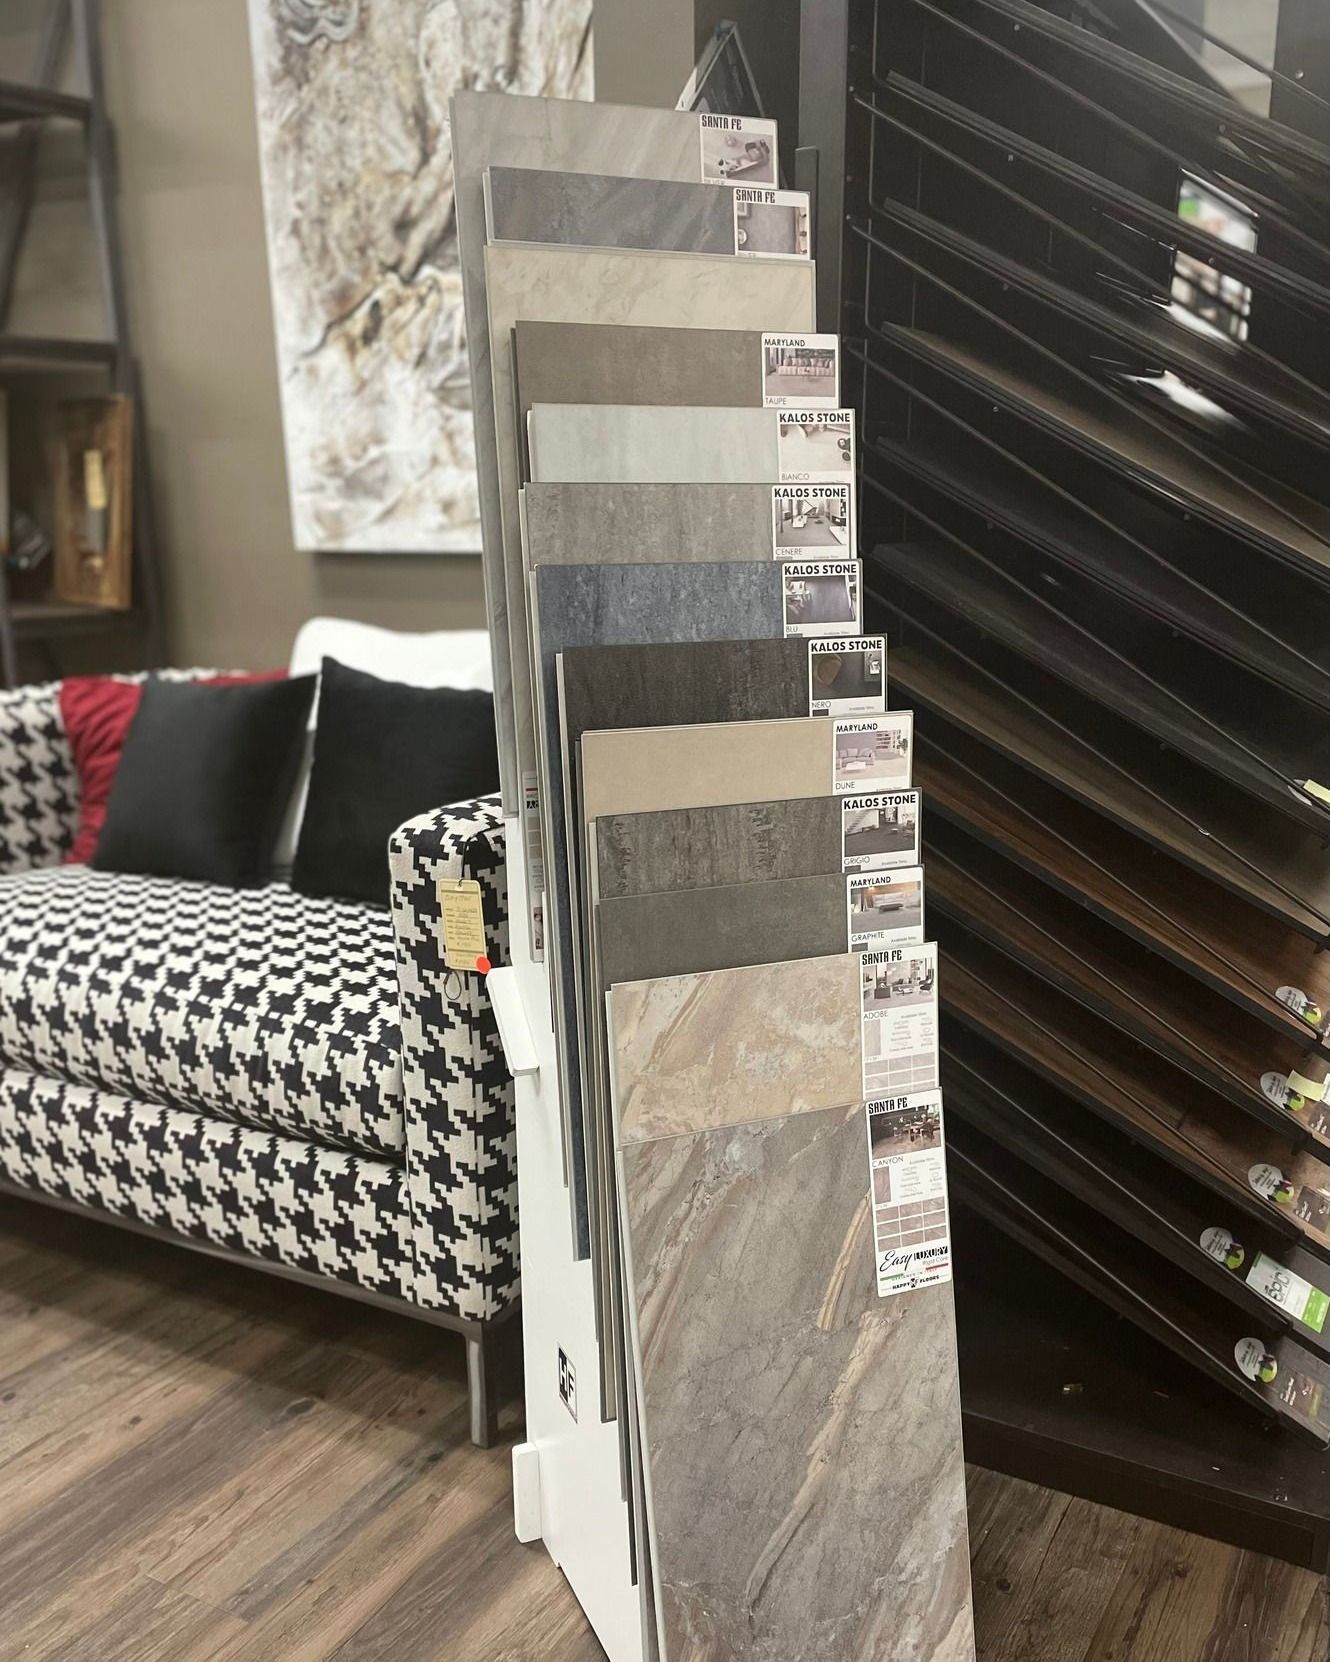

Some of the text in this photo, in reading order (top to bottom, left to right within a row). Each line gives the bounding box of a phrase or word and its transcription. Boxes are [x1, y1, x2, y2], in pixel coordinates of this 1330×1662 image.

[702, 114, 742, 131] SANTA FE
[736, 189, 776, 204] SANTA FE
[764, 338, 806, 347] MARYLAND
[765, 397, 787, 405] TAUPE
[779, 412, 850, 423] KALOS STONE
[781, 473, 810, 481] BIANCO
[774, 488, 846, 498] KALOS STONE
[775, 548, 803, 556] CENERE
[784, 564, 857, 575] KALOS STONE
[786, 625, 798, 633] BLU
[811, 640, 882, 652] KALOS STONE
[811, 701, 832, 709] NERO
[836, 722, 878, 733] MARYLAND
[835, 781, 855, 790] DUNE
[844, 794, 916, 810] KALOS STONE
[843, 855, 871, 865] GRIGIO
[850, 876, 892, 887] MARYLAND
[851, 932, 885, 942] GRAPHITE
[862, 949, 902, 965] SANTA FE
[863, 1010, 888, 1020] ADOBE
[868, 1097, 908, 1114] SANTA FE
[872, 1156, 904, 1168] CANYON
[879, 1246, 948, 1272] Easy LUXURY
[892, 1282, 910, 1290] HAPPY
